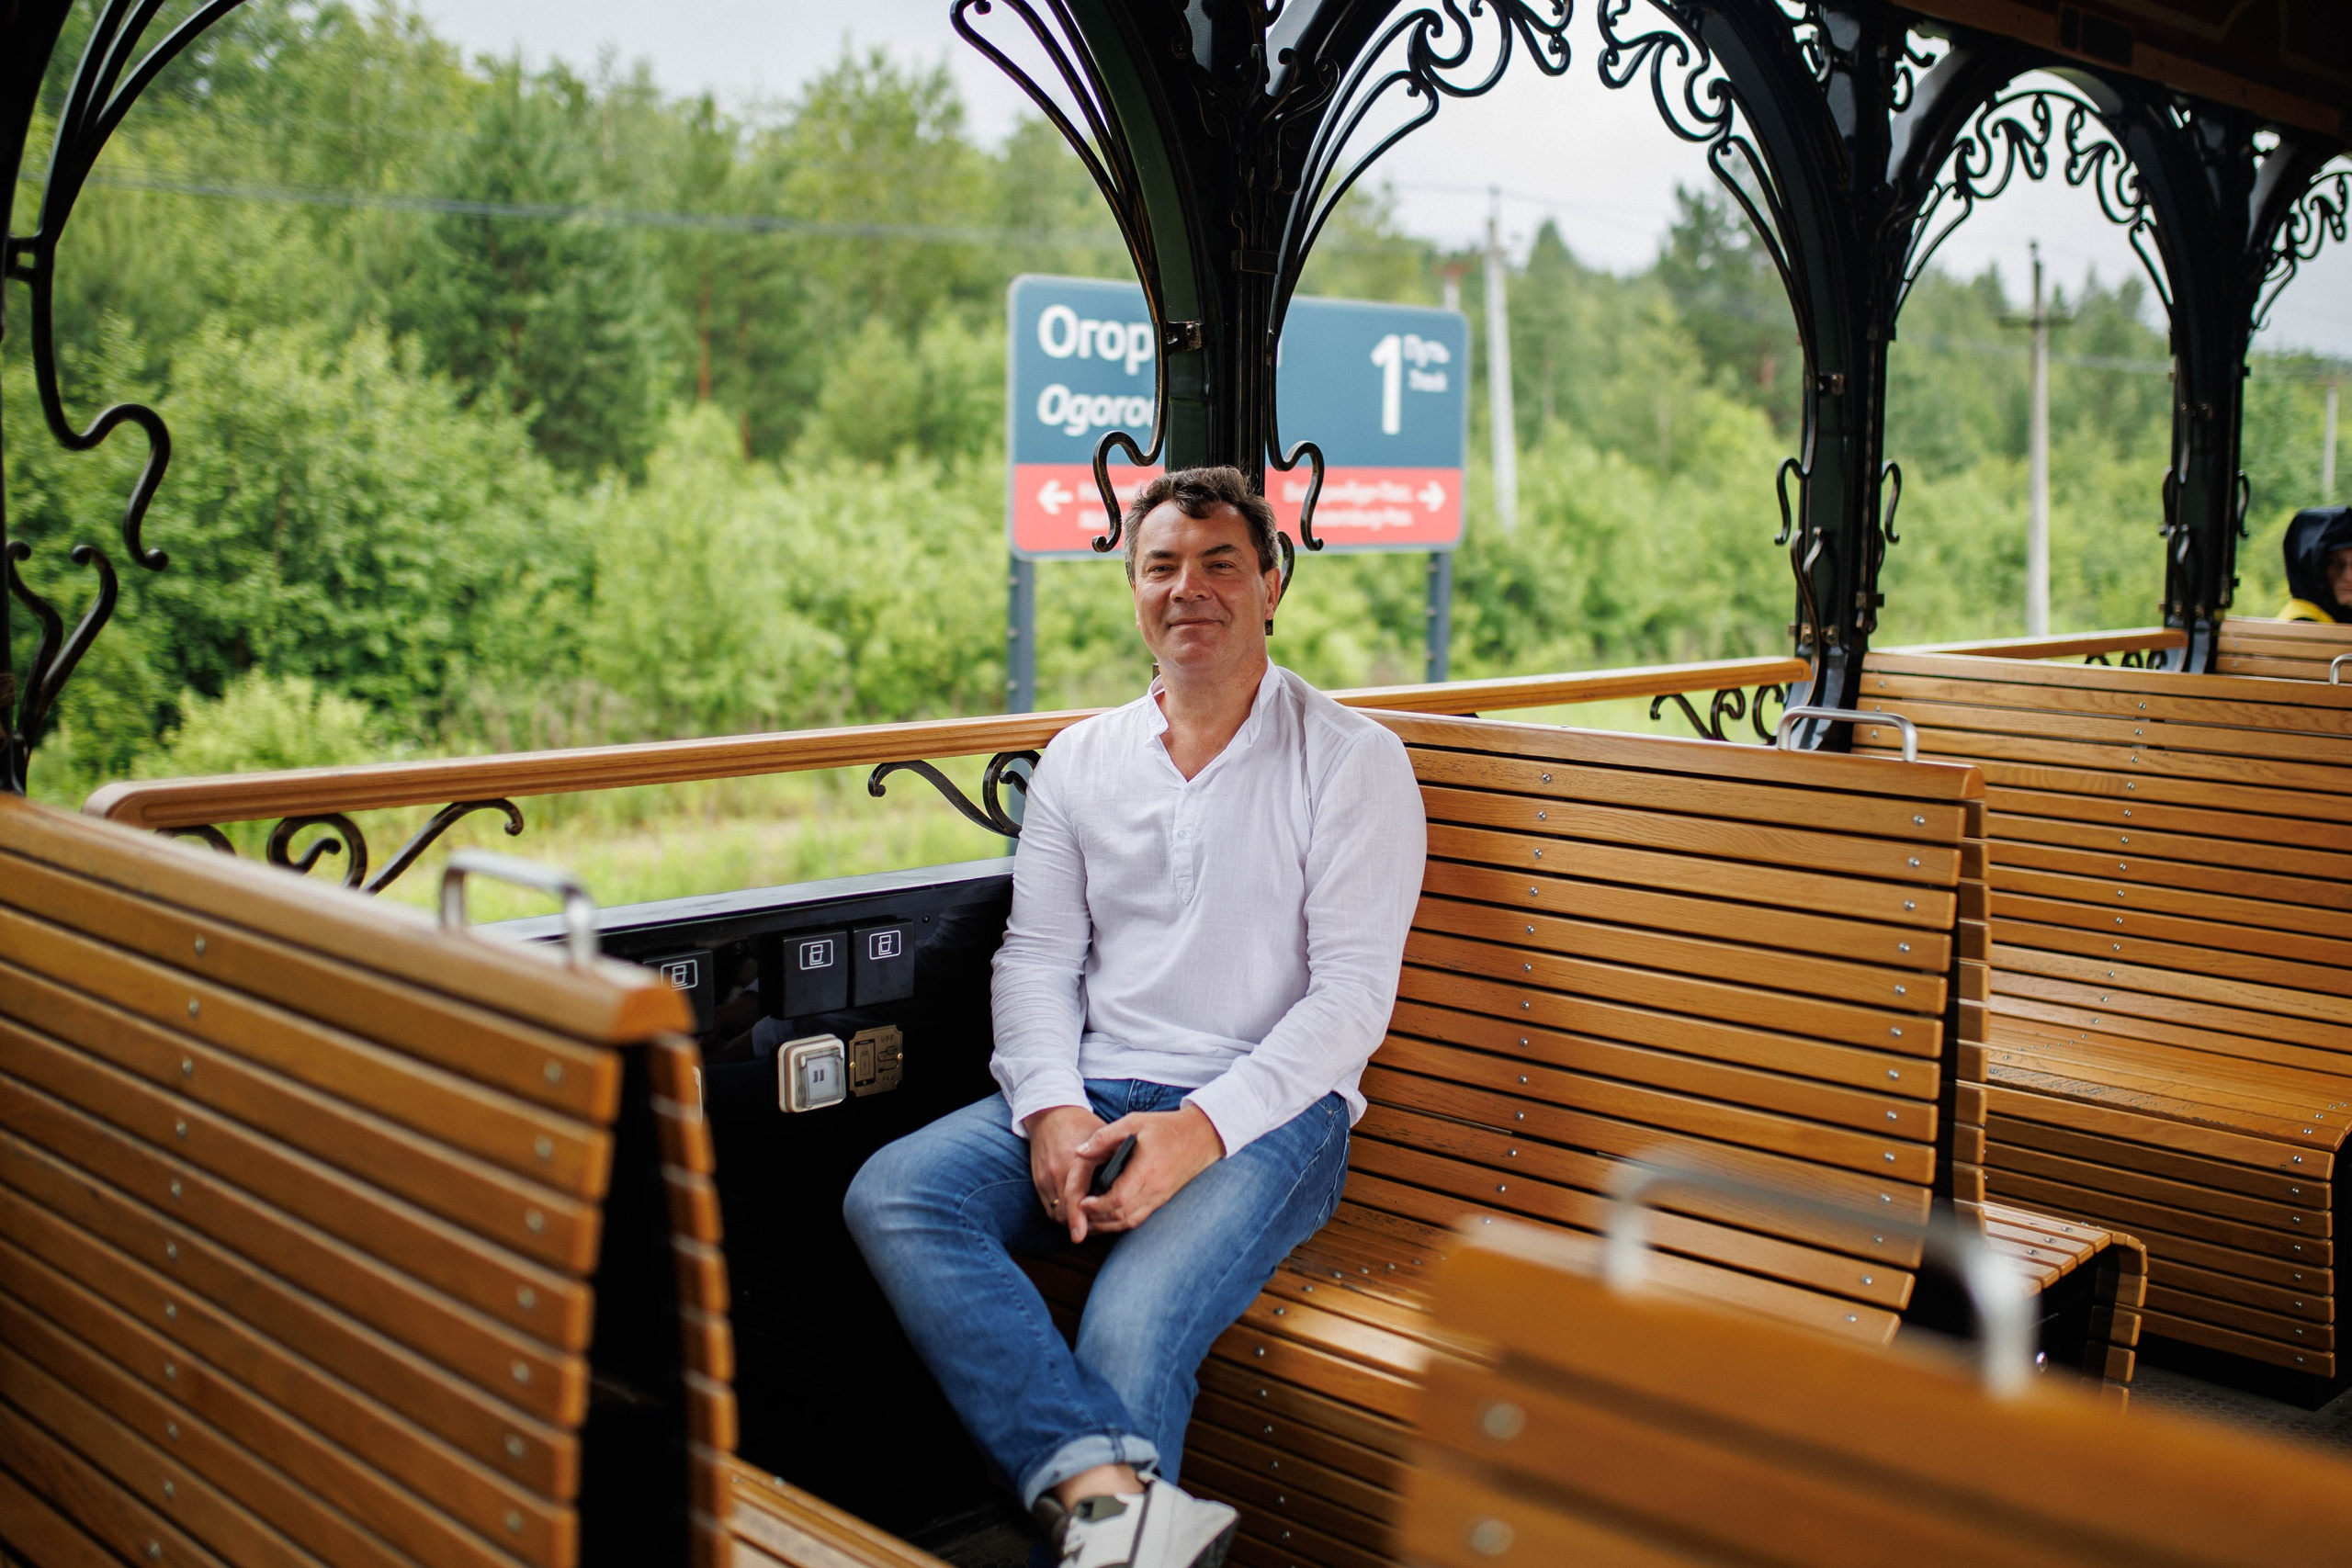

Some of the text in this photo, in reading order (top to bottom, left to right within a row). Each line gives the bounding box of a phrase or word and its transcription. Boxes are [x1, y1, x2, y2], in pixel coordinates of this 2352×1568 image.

[1038, 304, 1155, 376] Огор
[1037, 384, 1155, 436] Ogoro
[1370, 333, 1401, 435] 1
